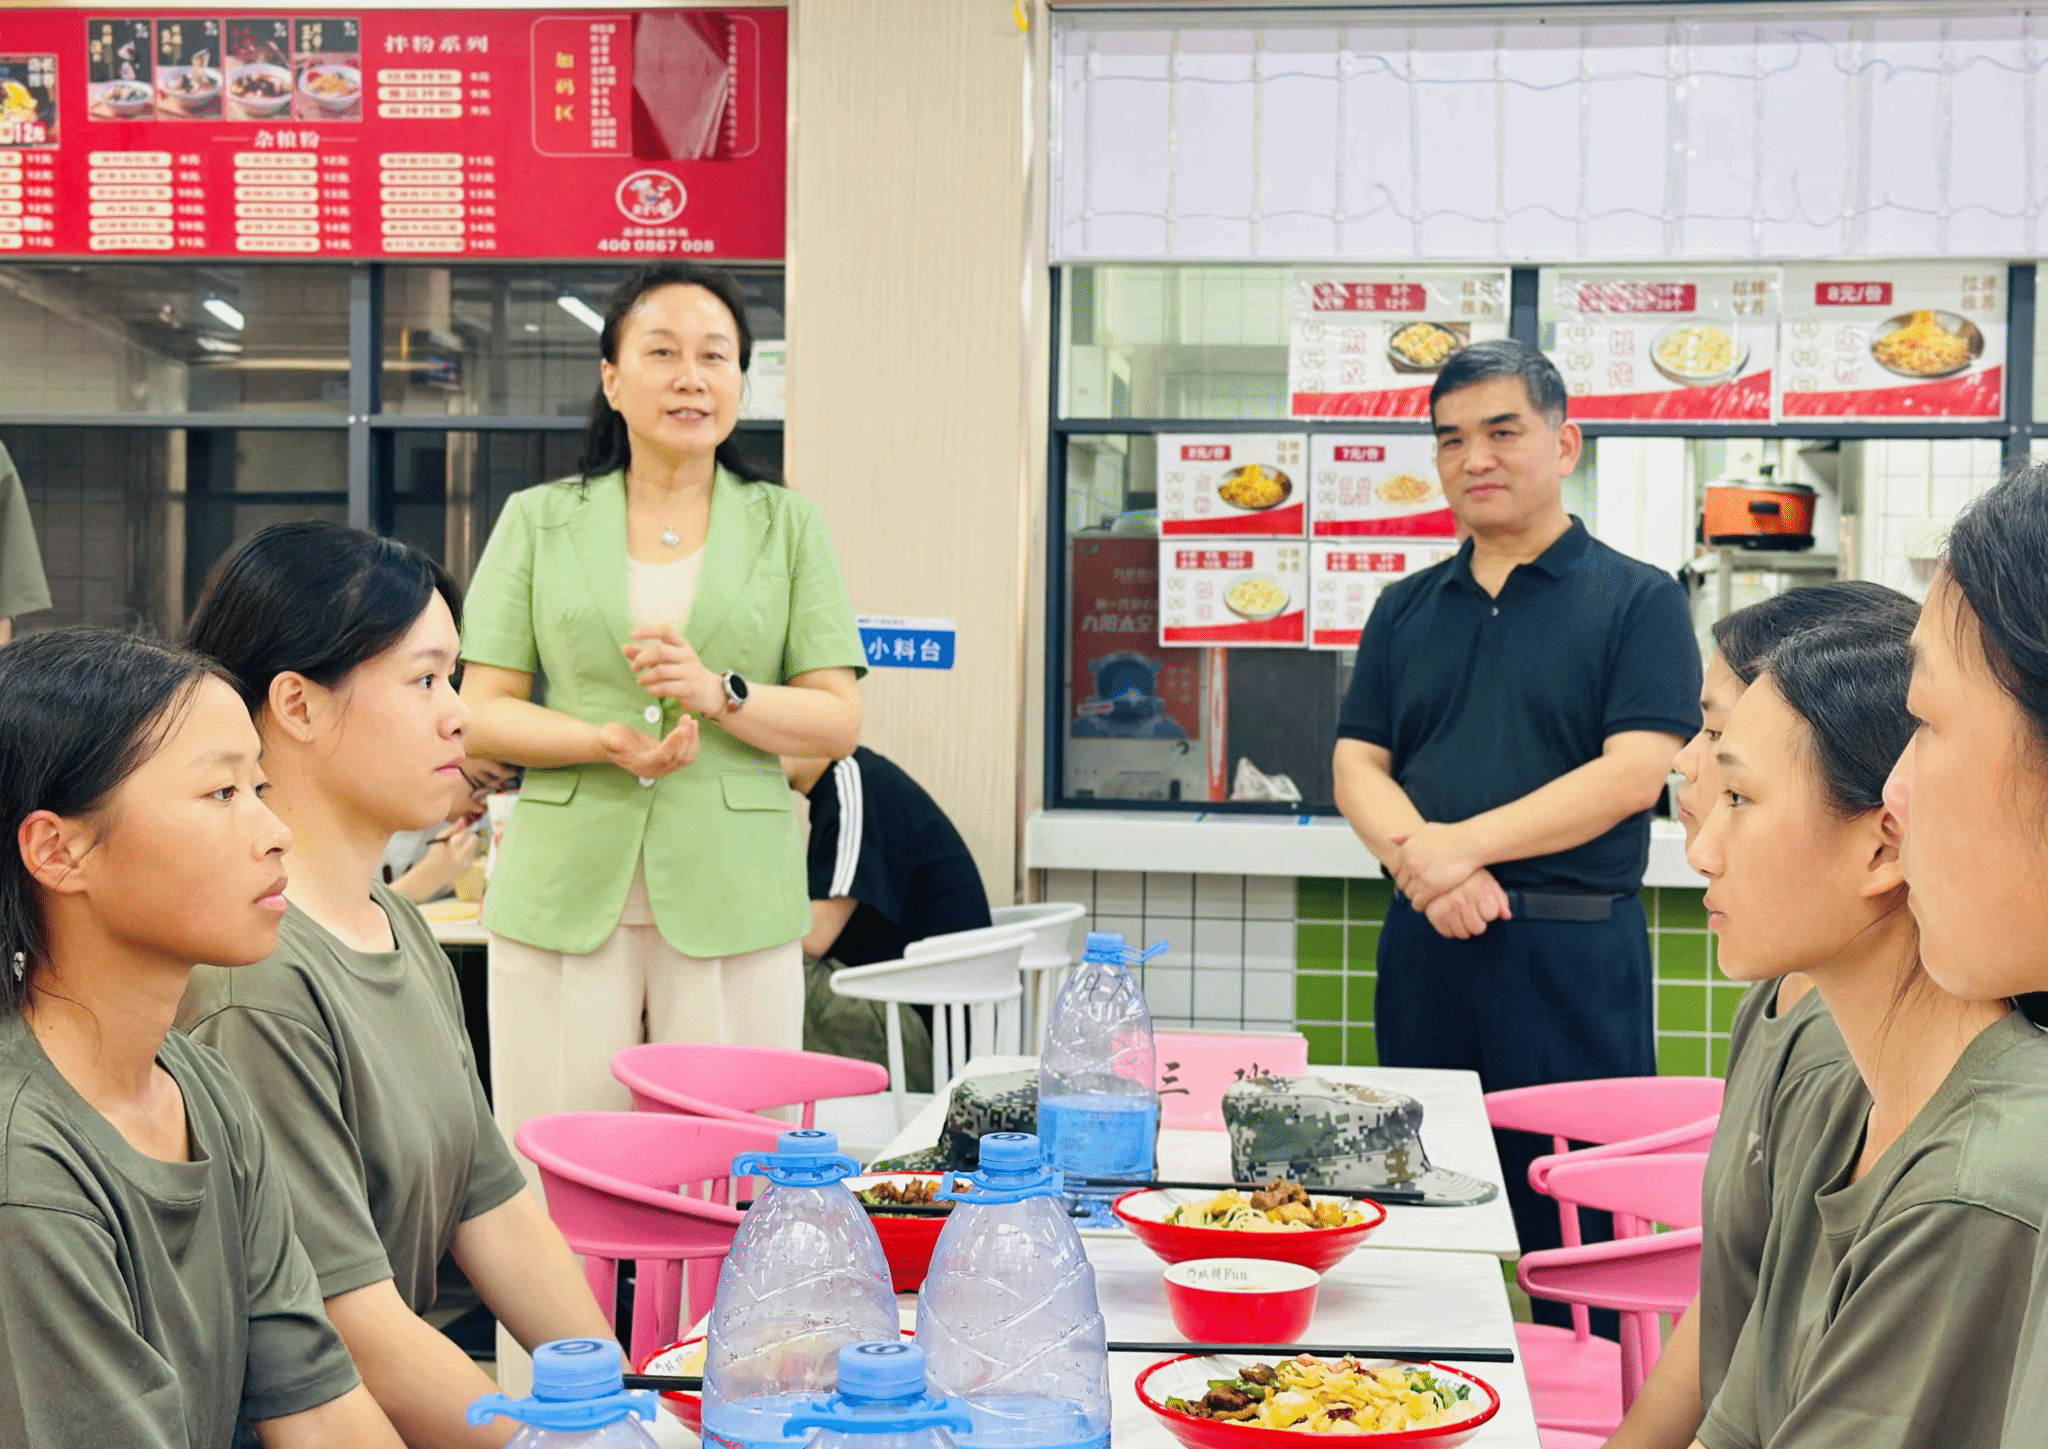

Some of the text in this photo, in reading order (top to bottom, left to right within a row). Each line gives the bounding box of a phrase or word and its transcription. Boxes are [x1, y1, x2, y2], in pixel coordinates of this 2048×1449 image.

[384, 35, 488, 53] 拌粉系列
[597, 239, 631, 252] 400
[681, 239, 714, 253] 008
[1827, 285, 1882, 301] 8元/份
[868, 636, 941, 662] 小料台
